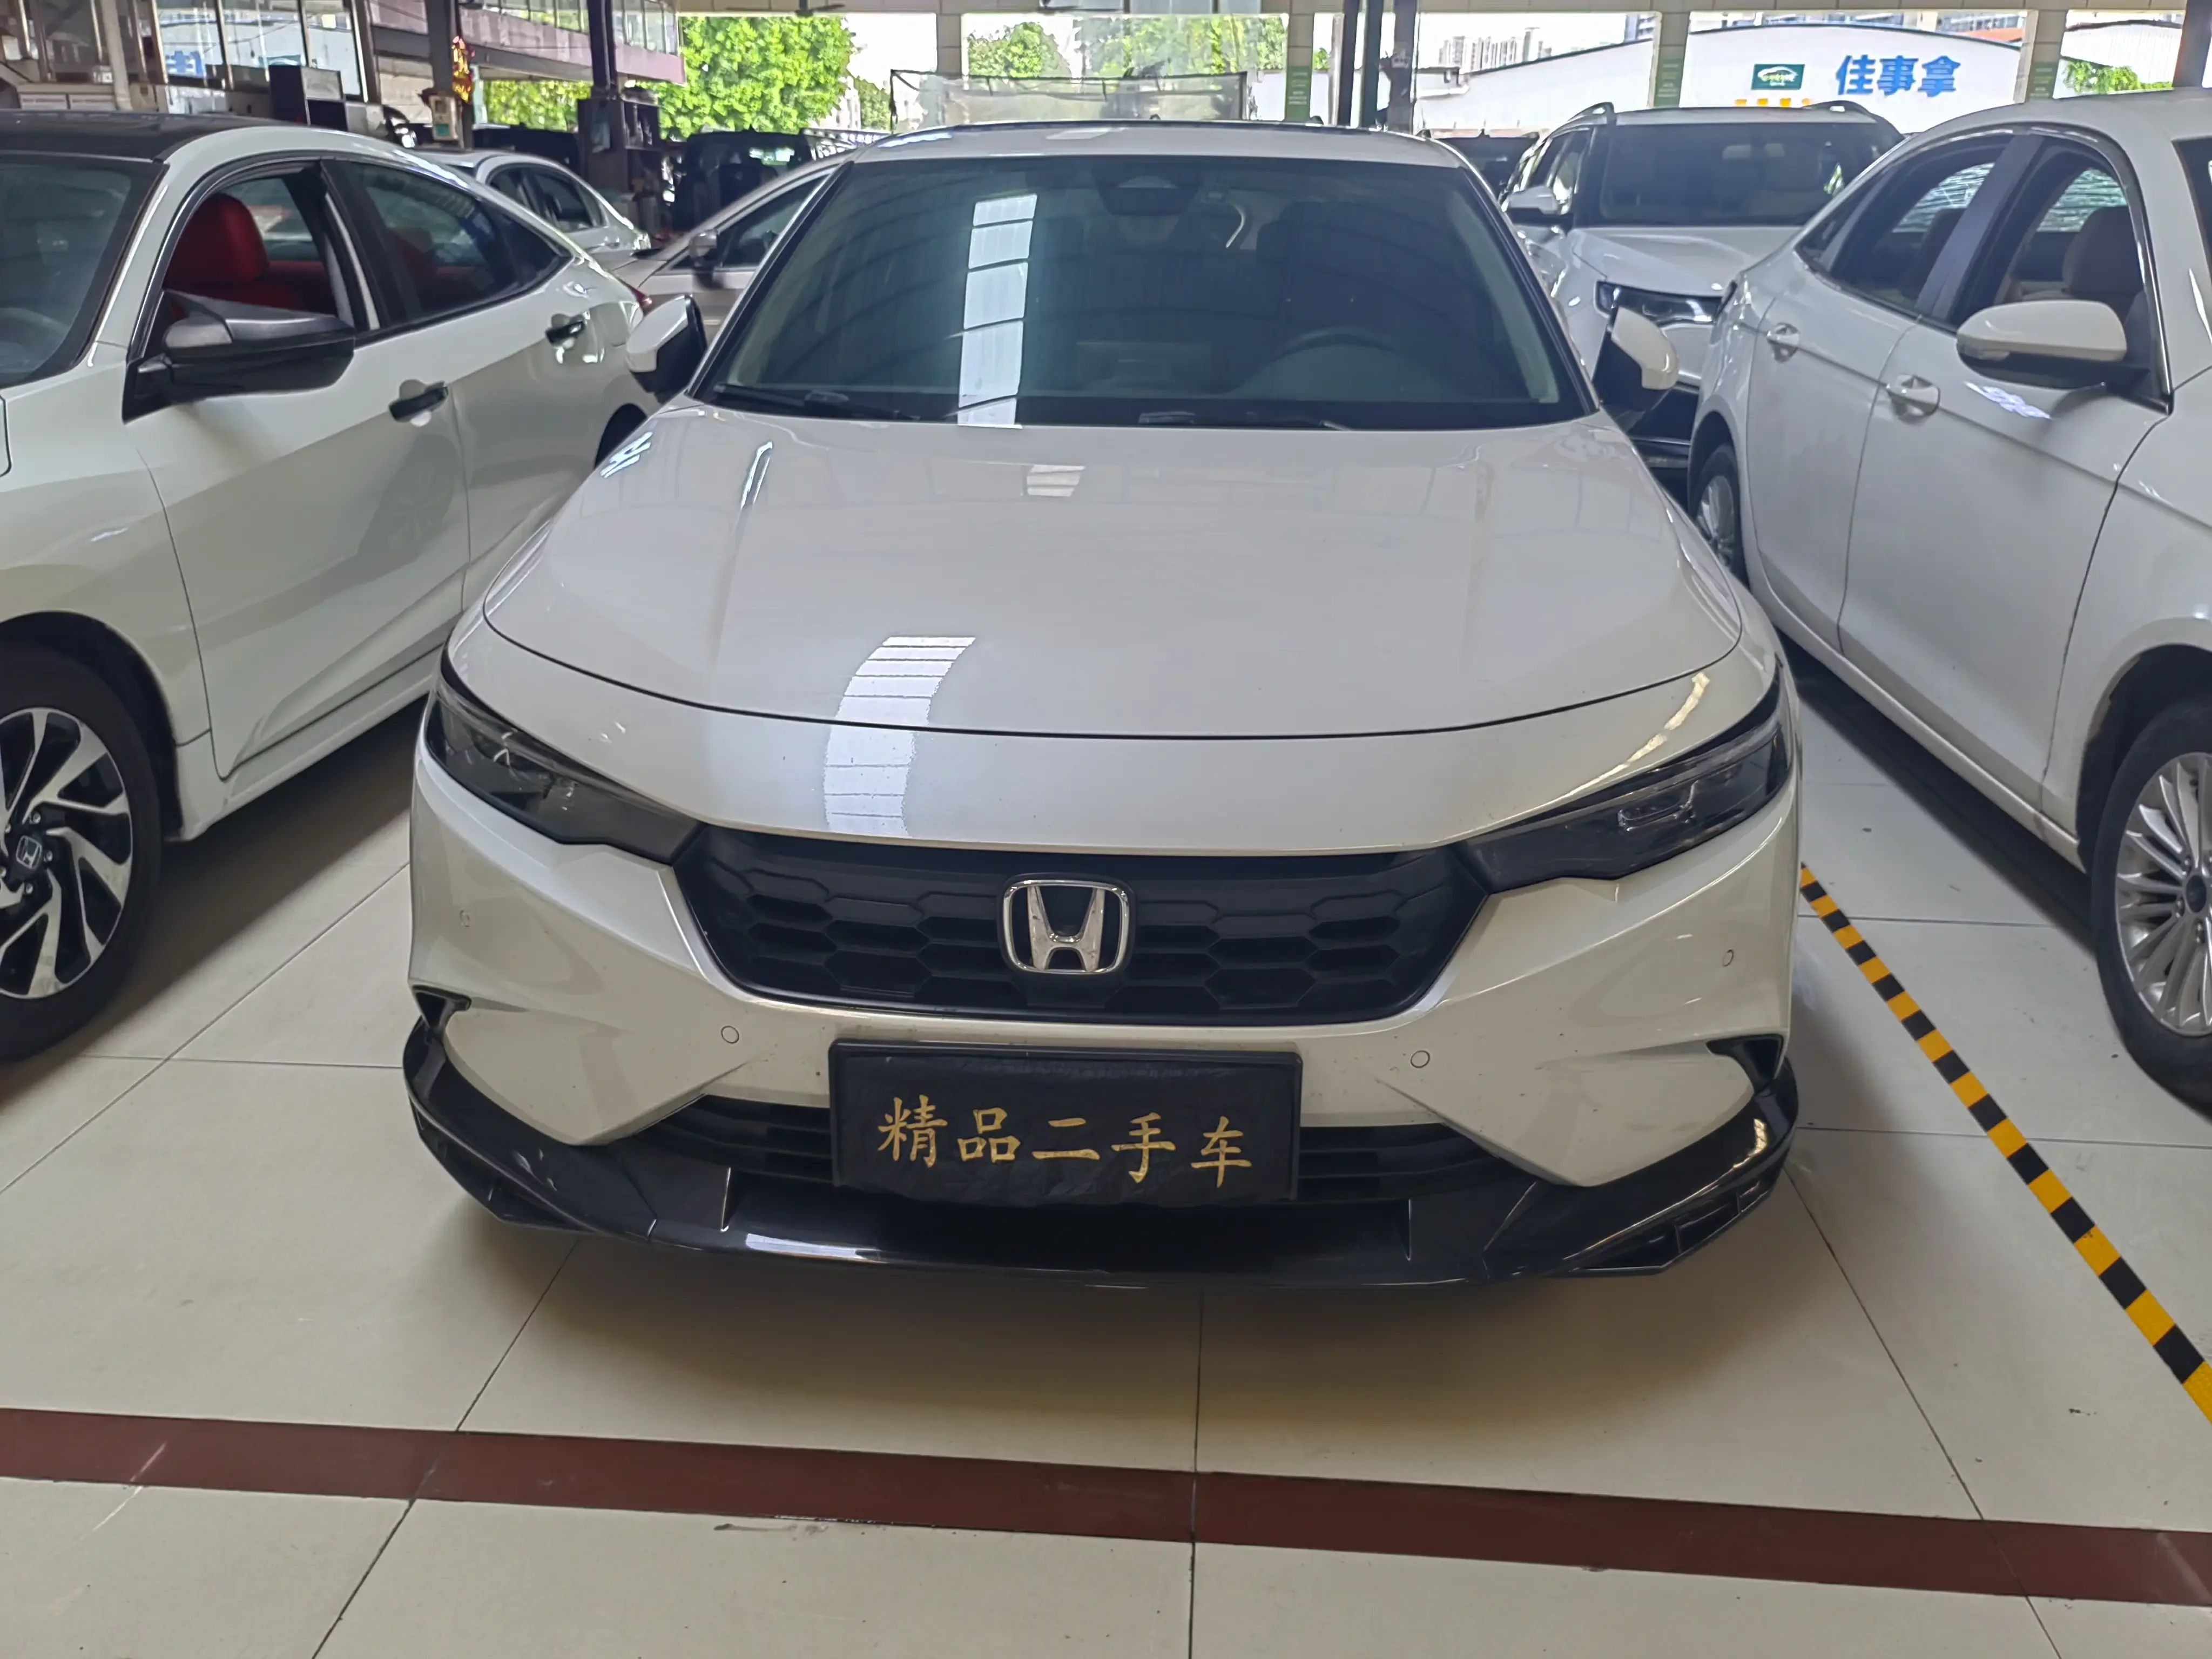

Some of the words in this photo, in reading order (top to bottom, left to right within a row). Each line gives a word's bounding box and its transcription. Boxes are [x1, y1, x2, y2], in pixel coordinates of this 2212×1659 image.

[1835, 55, 1961, 98] 佳事拿
[878, 1094, 1252, 1188] 精品二手车
